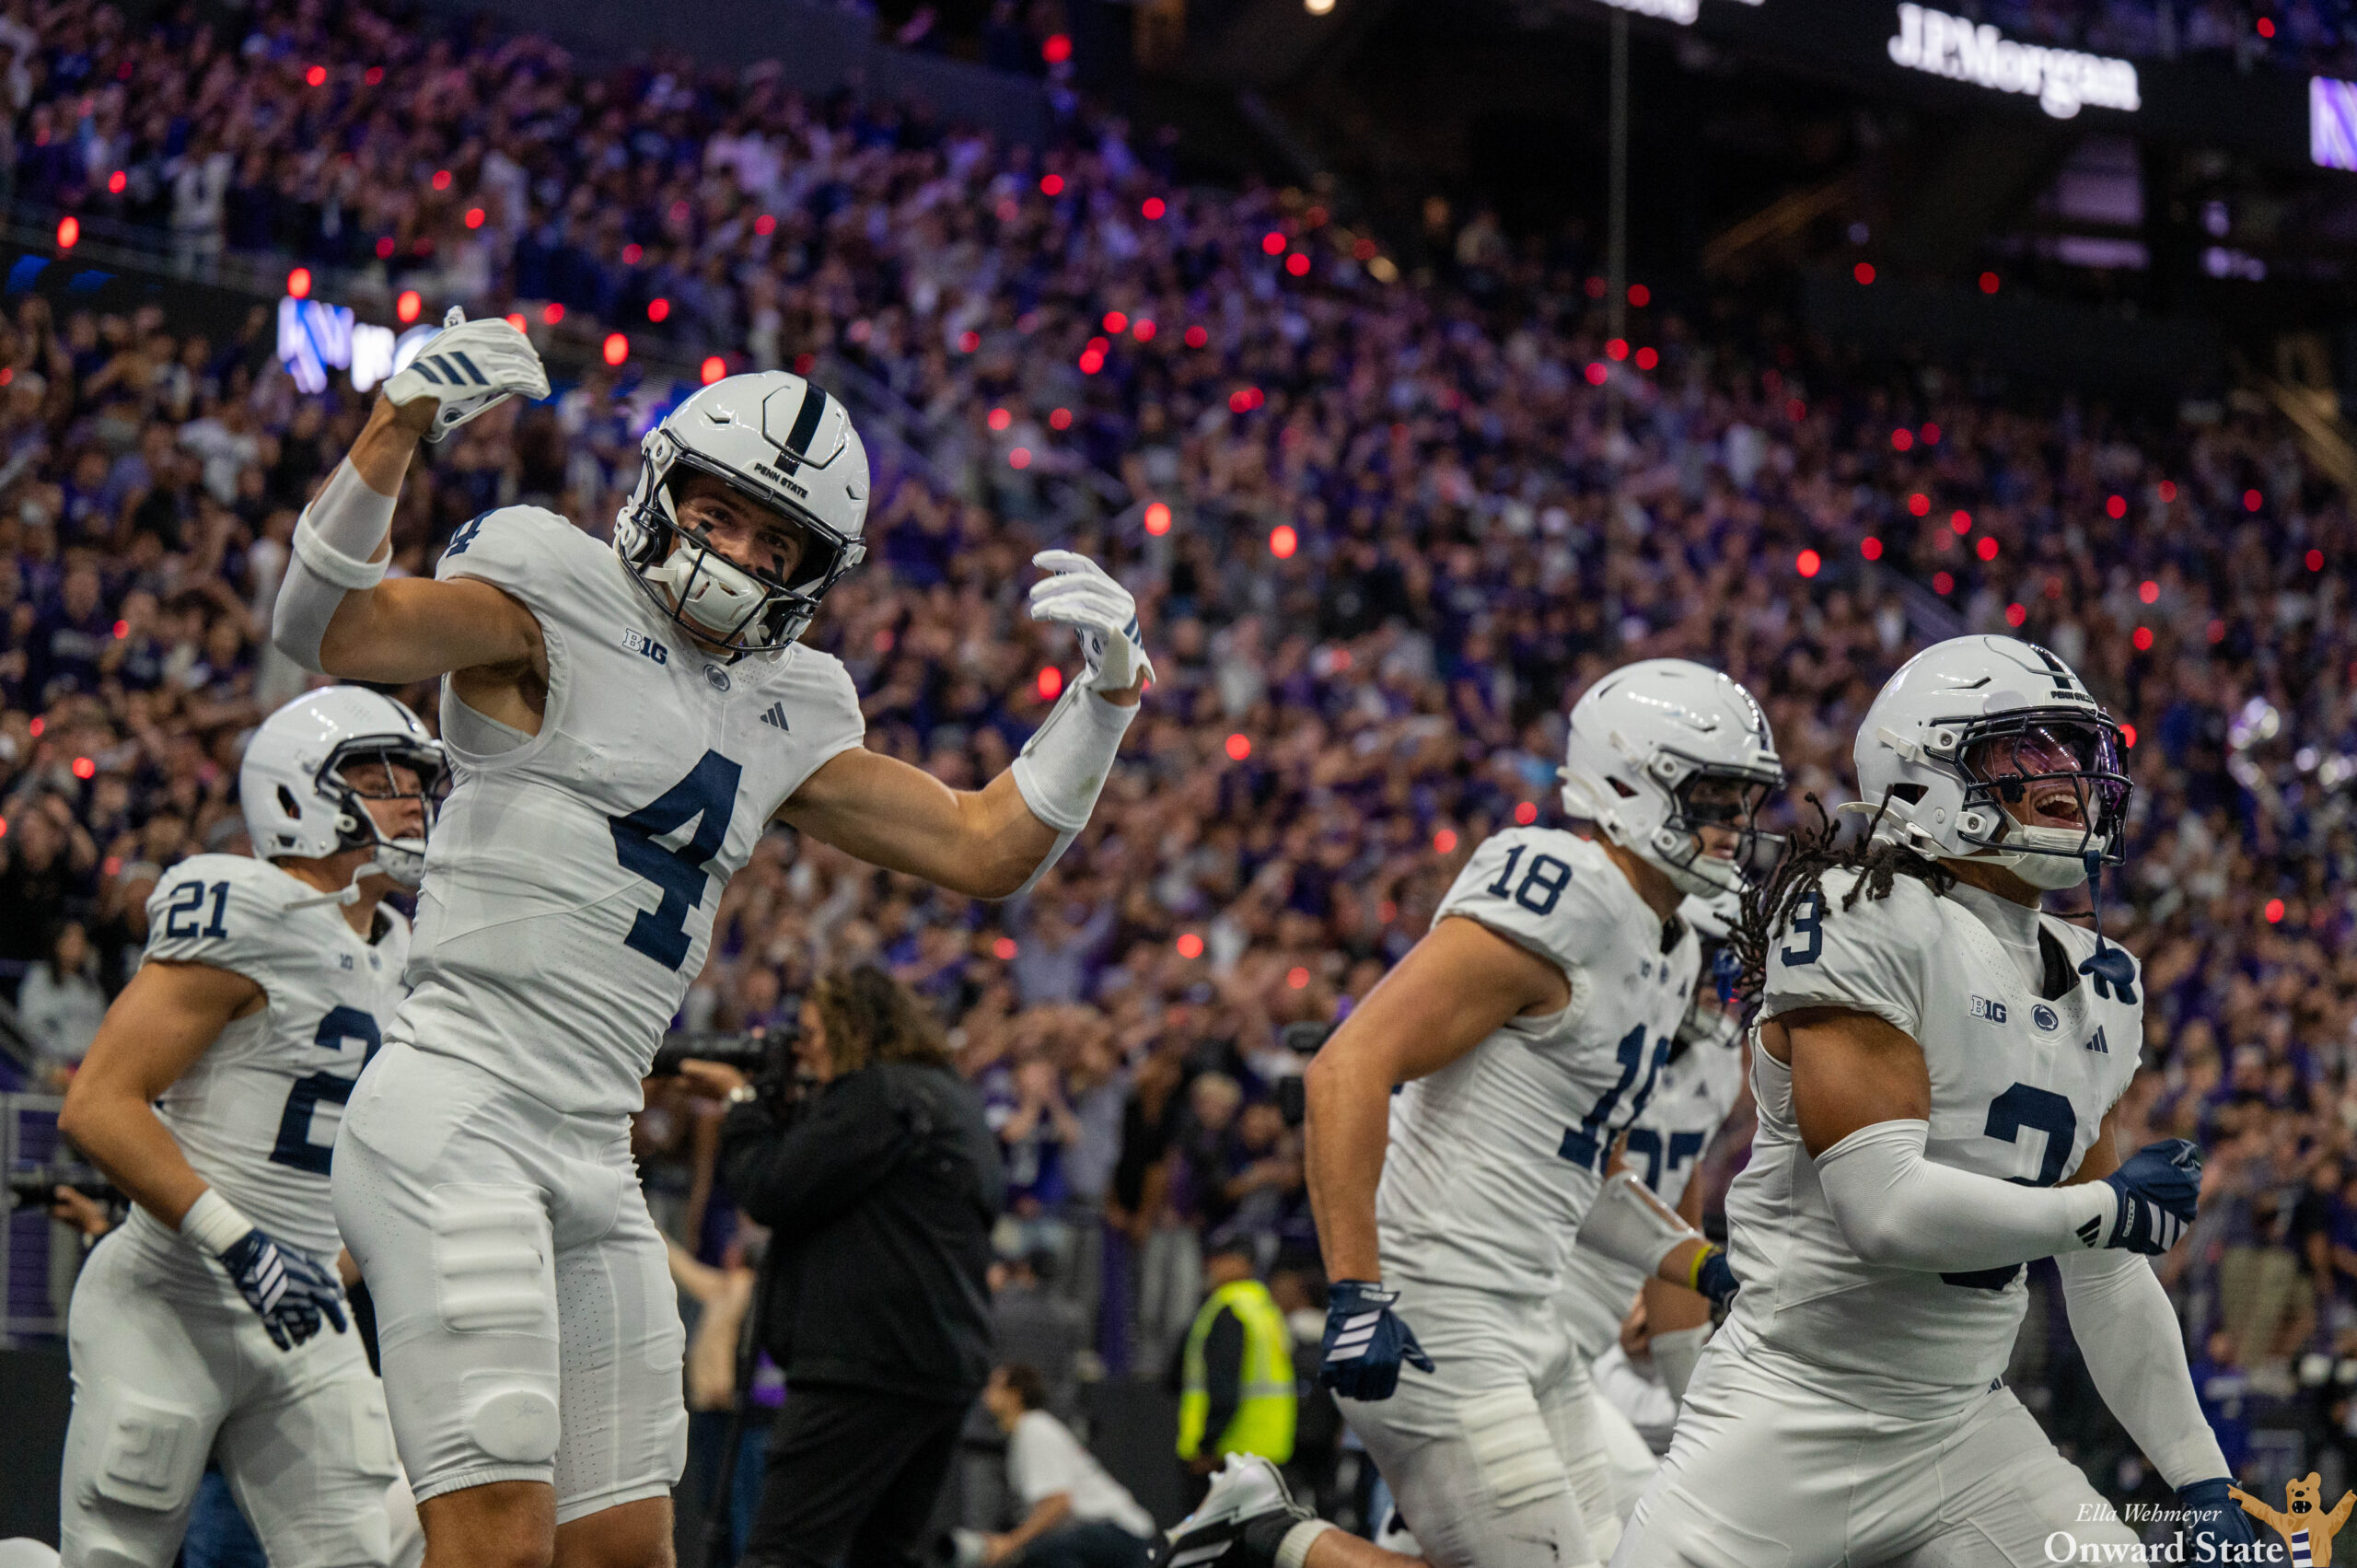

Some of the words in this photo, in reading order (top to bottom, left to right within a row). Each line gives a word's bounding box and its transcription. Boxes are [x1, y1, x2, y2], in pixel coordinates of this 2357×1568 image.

[754, 462, 781, 482] PENN
[780, 477, 808, 498] STATE
[609, 748, 742, 972] 4
[1488, 844, 1572, 915] 18
[167, 879, 231, 940] 21
[1781, 890, 1823, 968] 3
